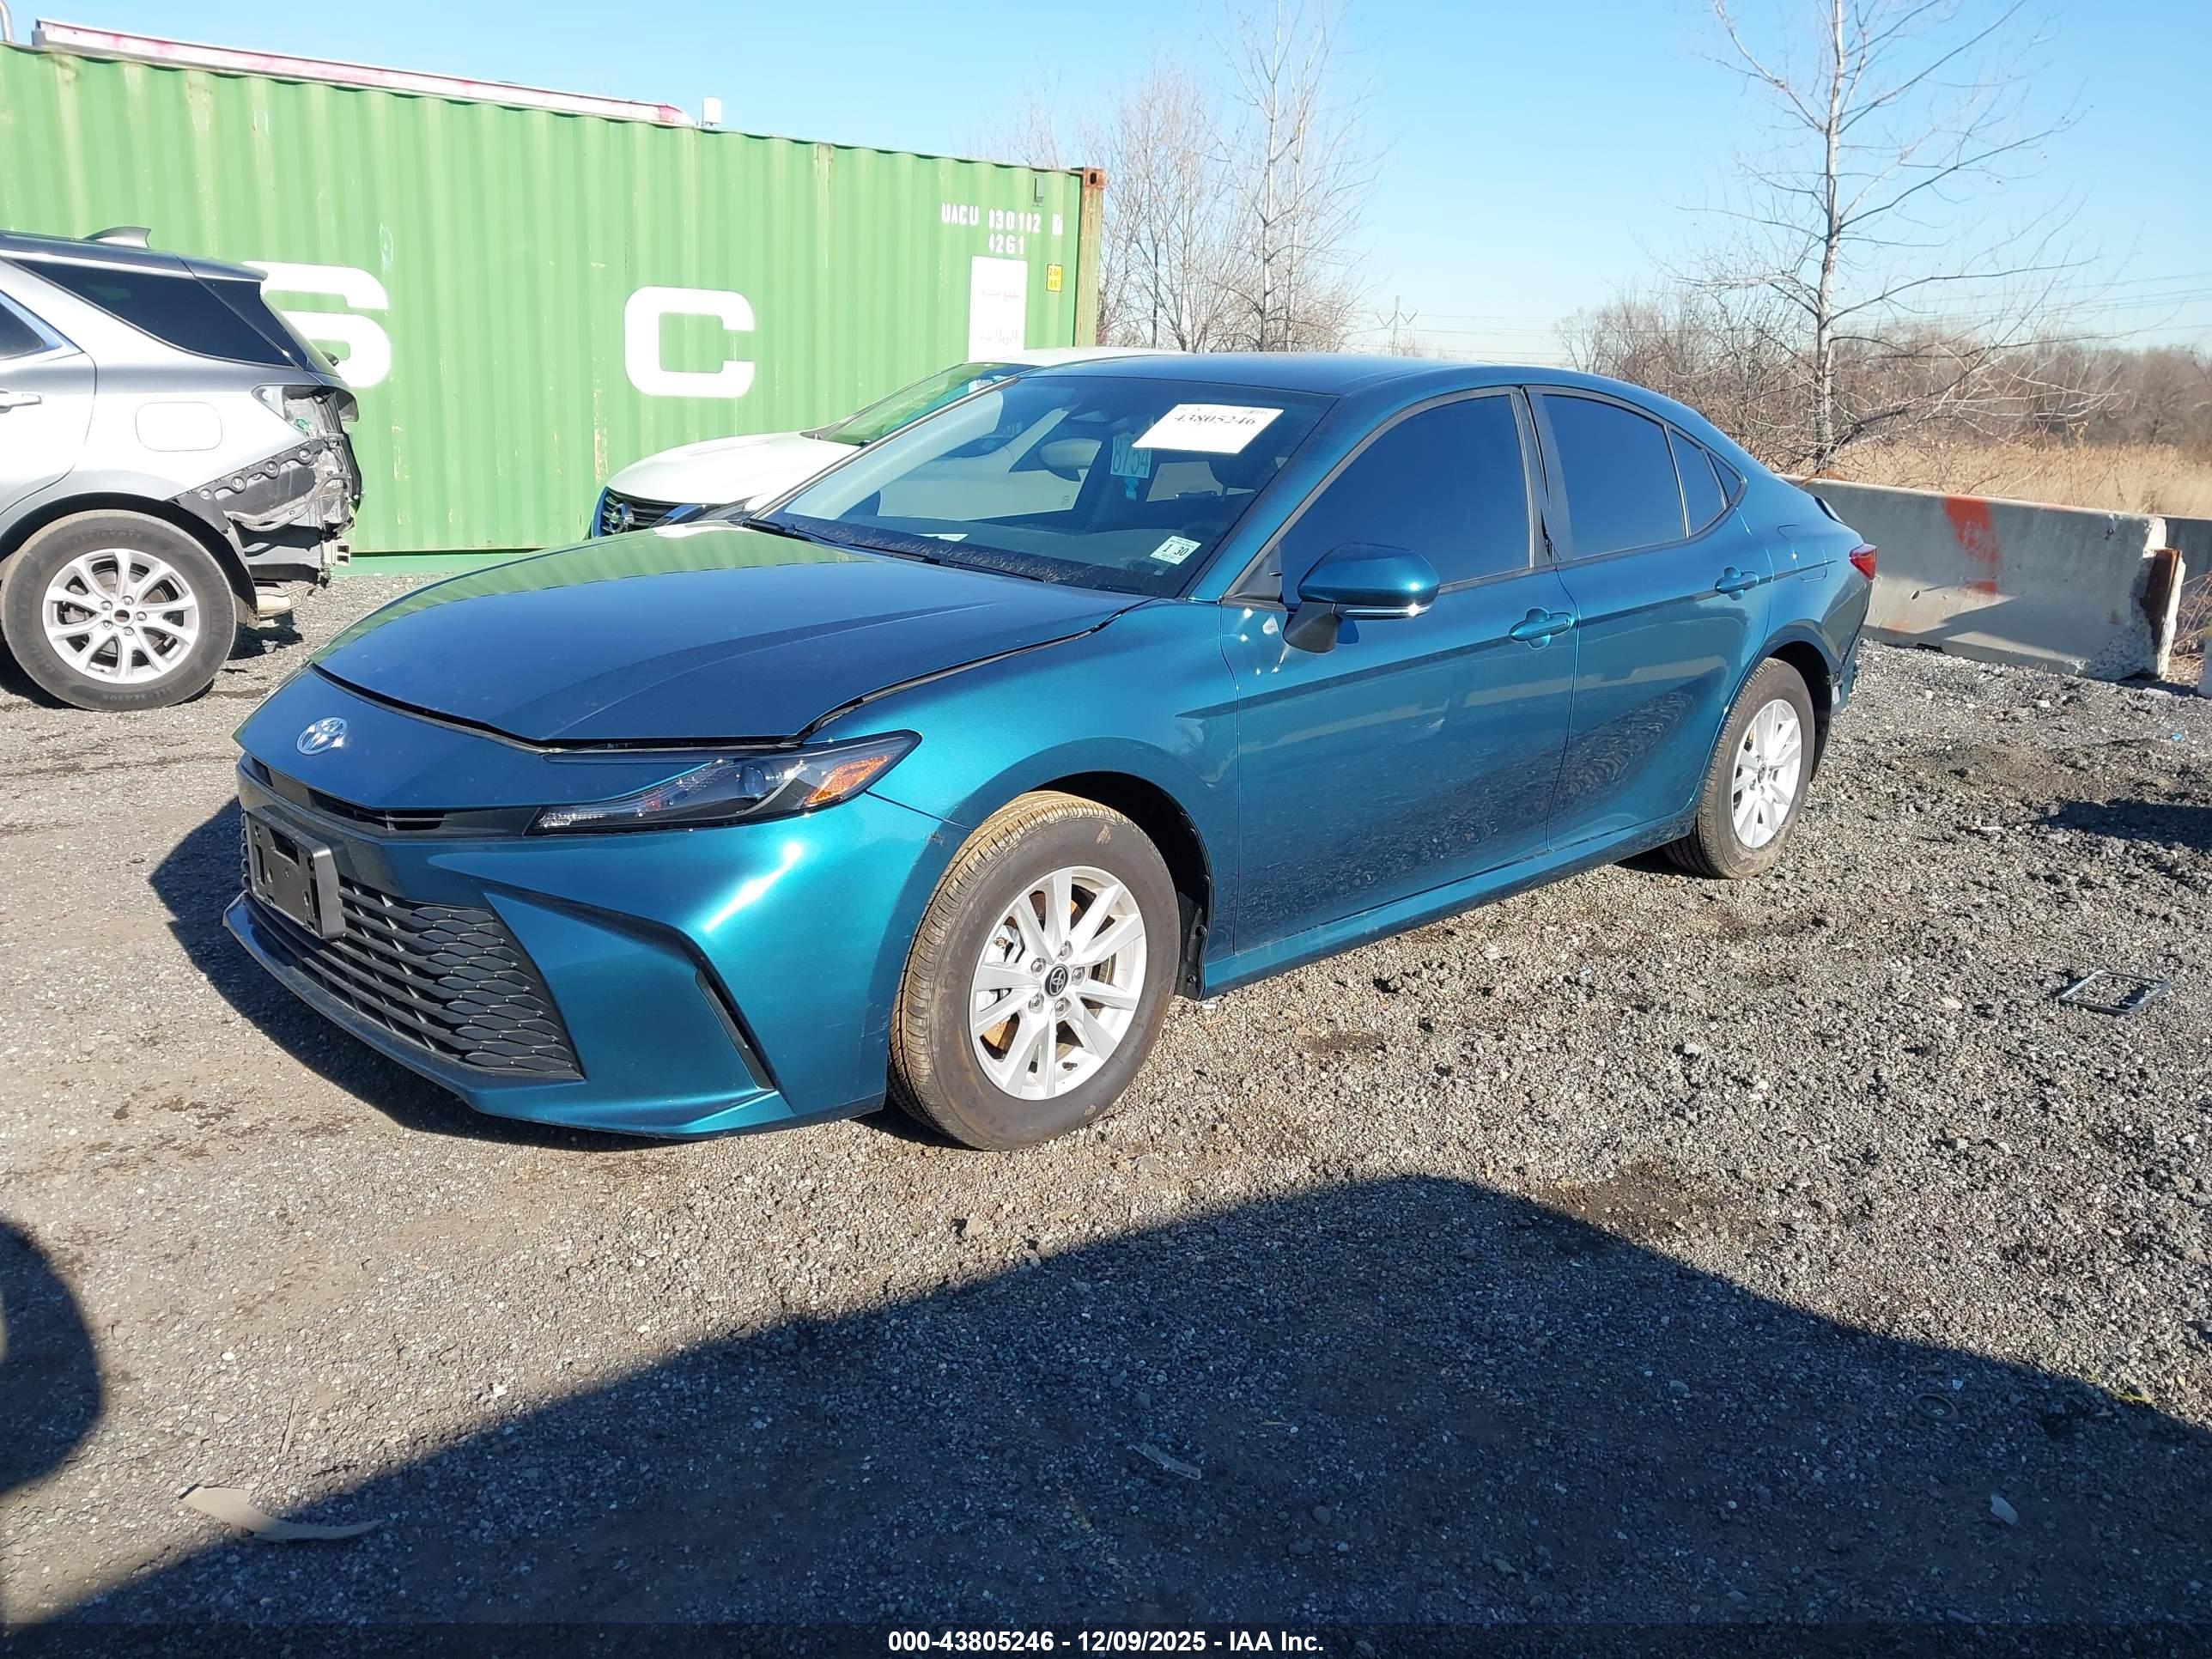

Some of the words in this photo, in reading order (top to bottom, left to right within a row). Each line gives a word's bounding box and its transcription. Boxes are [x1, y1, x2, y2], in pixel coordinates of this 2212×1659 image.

[941, 203, 980, 225] UACU
[623, 285, 756, 398] C
[1174, 413, 1256, 426] 43805246
[1174, 546, 1189, 556] 30
